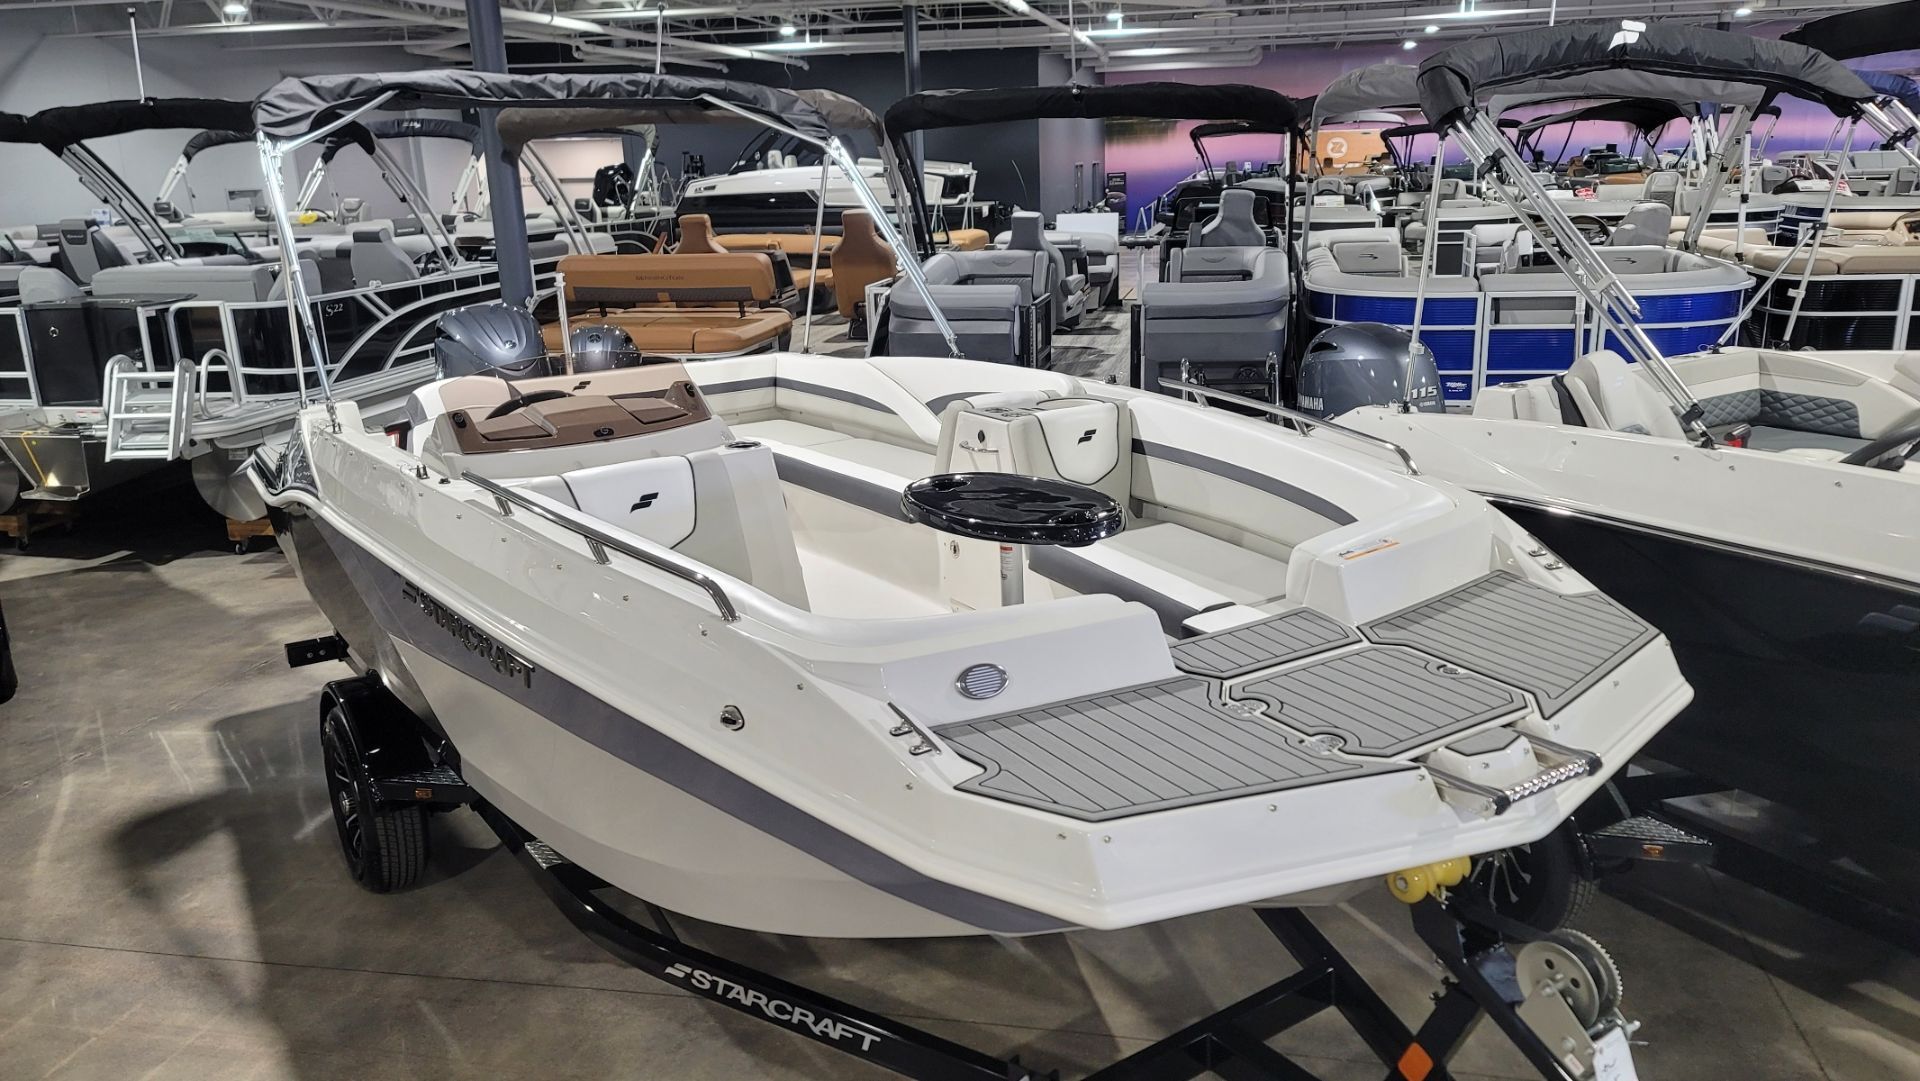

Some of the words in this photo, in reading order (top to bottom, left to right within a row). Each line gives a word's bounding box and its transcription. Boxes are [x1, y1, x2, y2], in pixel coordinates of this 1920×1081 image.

[1411, 386, 1437, 399] 115
[419, 591, 535, 688] STARCRAFT
[690, 969, 882, 1052] STARCRAFT
